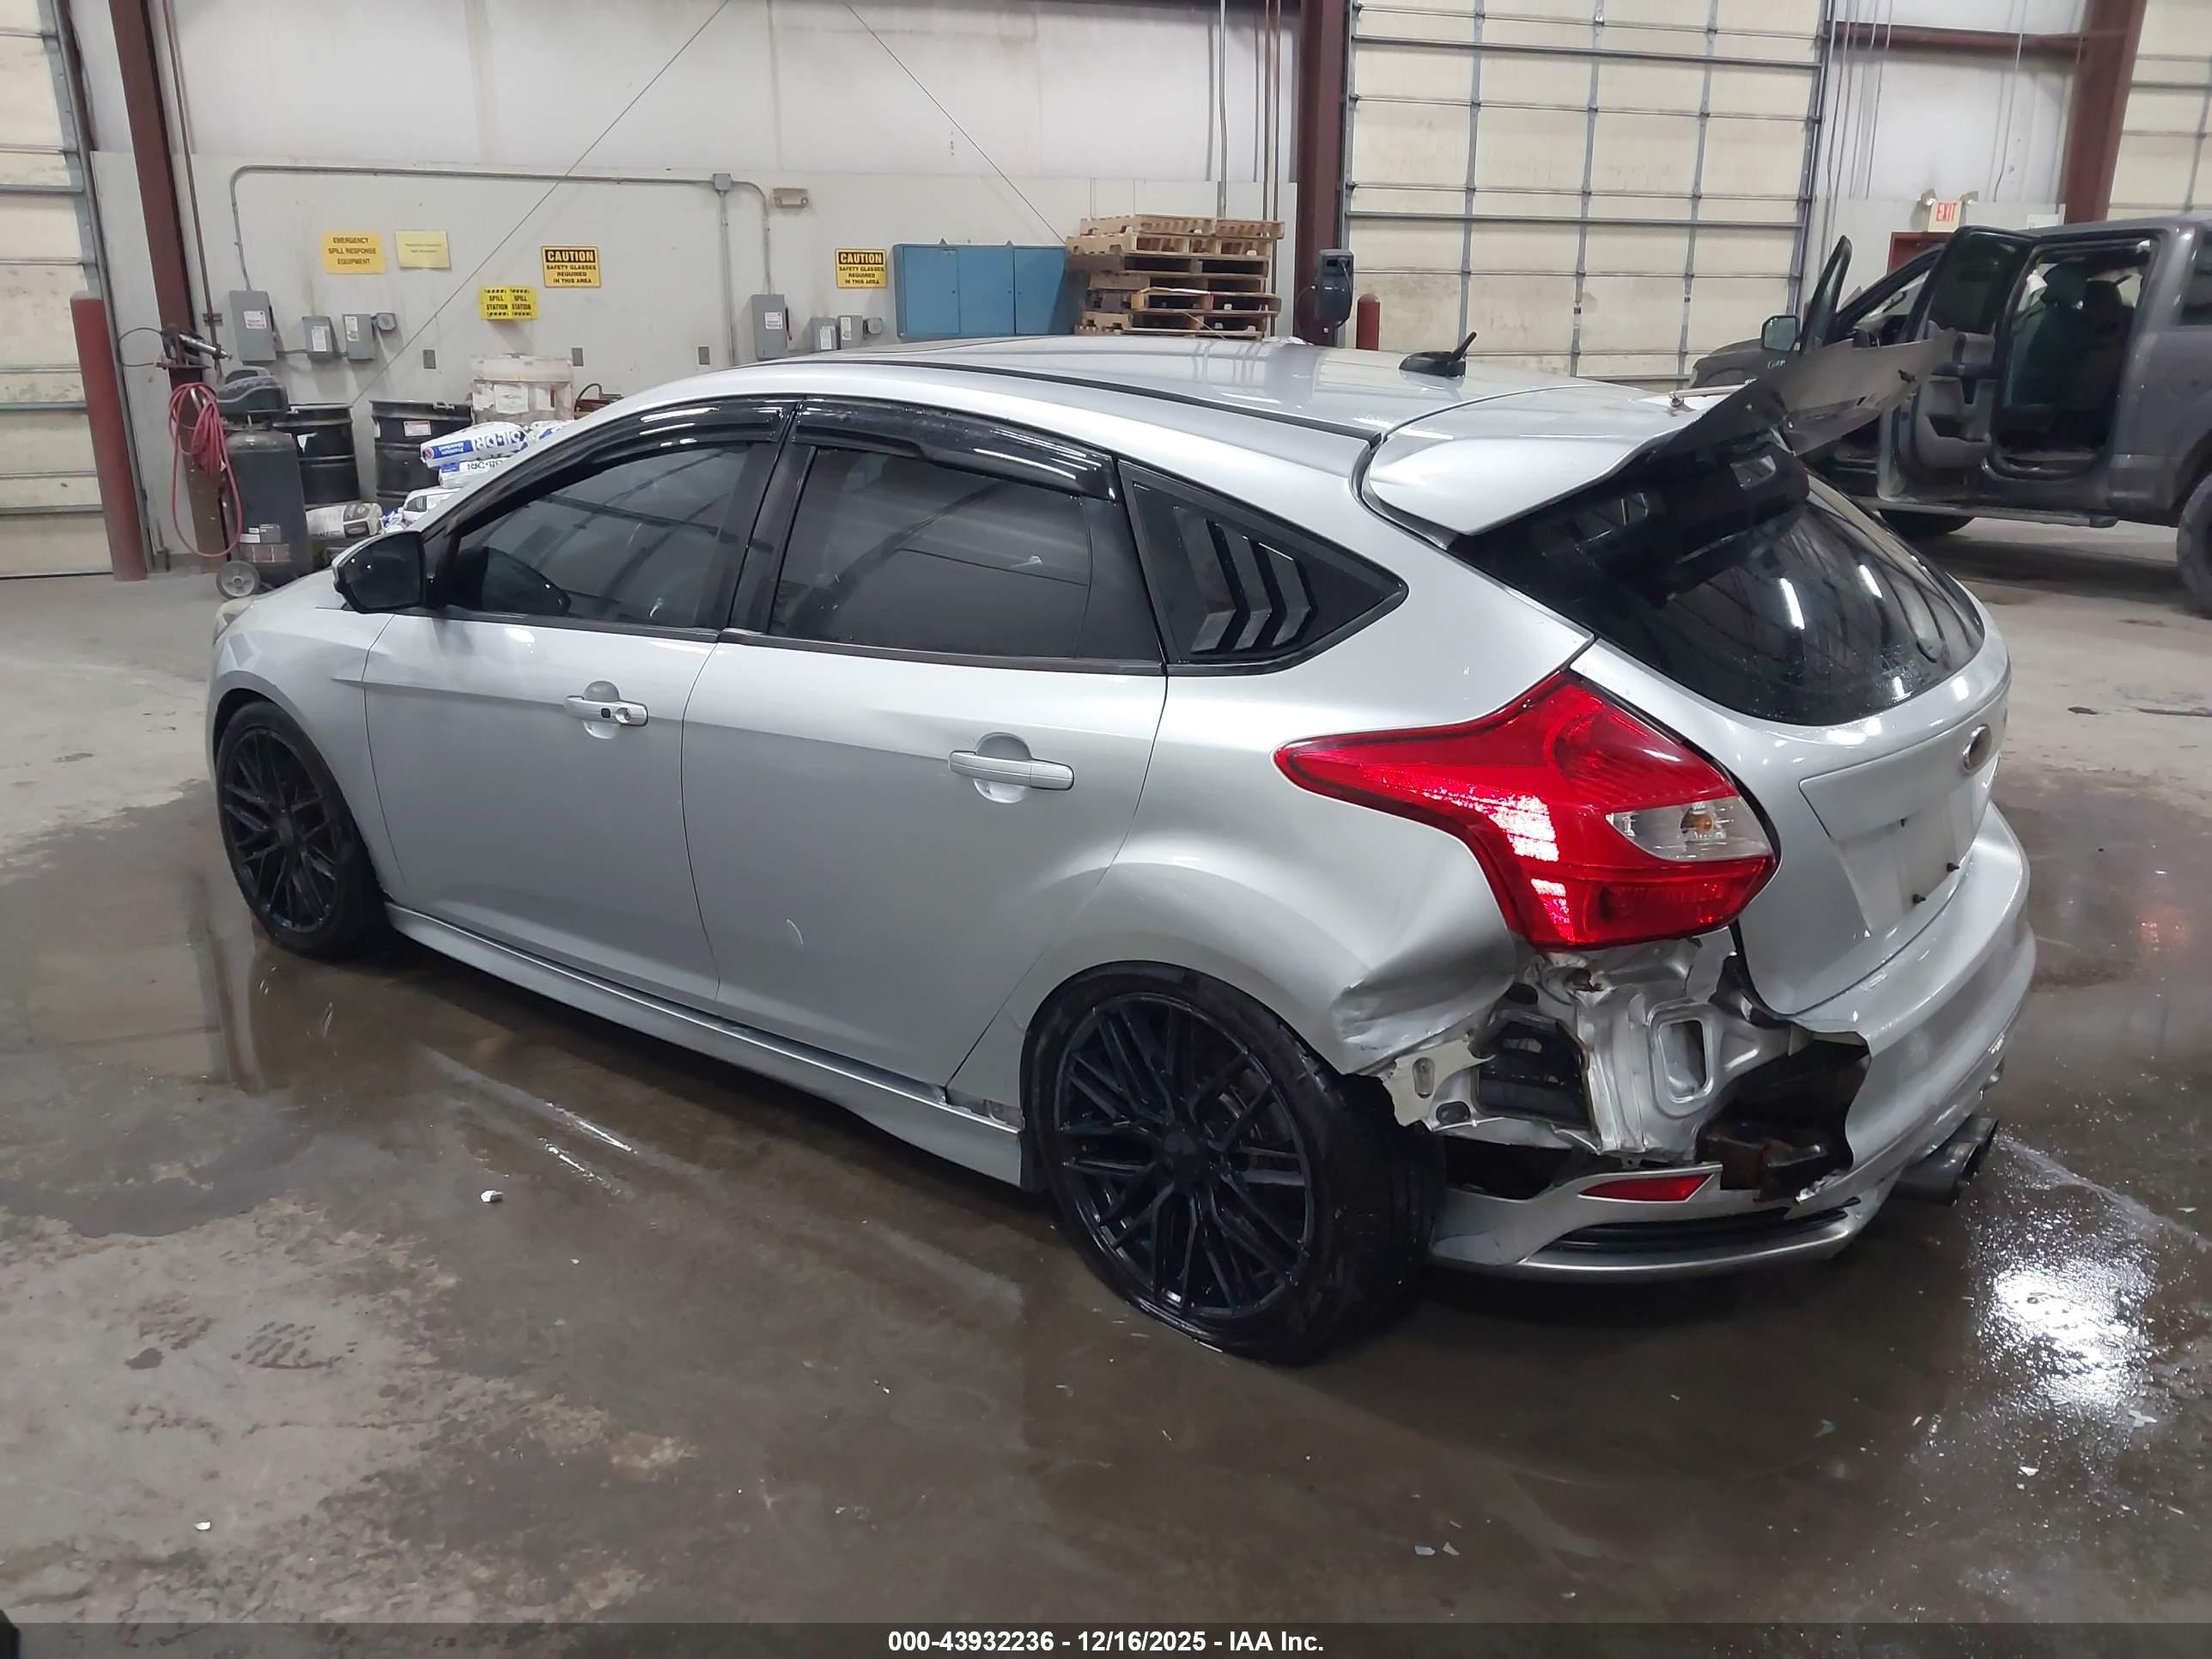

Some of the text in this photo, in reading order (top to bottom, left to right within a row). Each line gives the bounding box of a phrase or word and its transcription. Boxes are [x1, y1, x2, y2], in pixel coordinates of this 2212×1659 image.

[1937, 202, 1957, 221] EXIT
[547, 251, 594, 262] CAUTION
[840, 253, 882, 264] CAUTION
